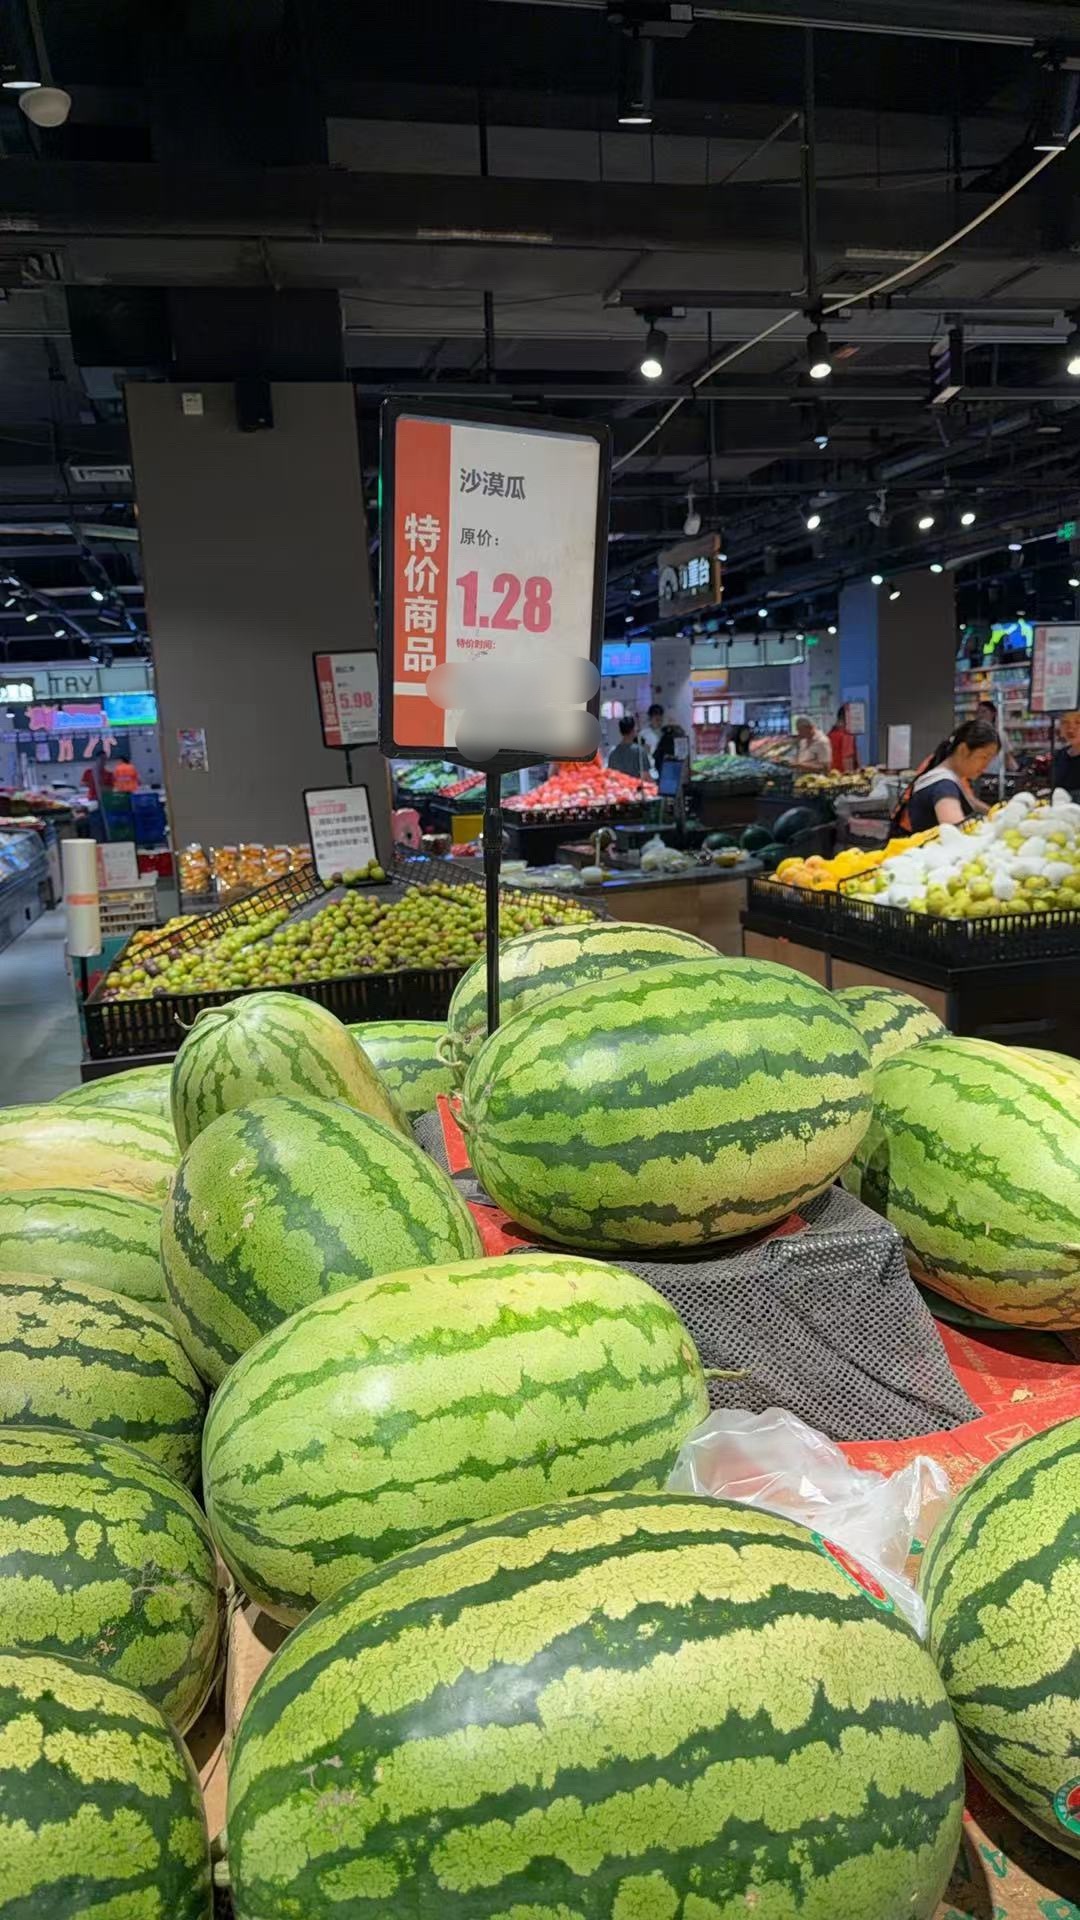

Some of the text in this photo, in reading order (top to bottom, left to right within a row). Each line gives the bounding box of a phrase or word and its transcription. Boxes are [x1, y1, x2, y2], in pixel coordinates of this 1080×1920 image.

[459, 467, 526, 500] 沙漠瓜
[403, 512, 441, 672] 特价商品
[455, 570, 553, 634] 1.28
[37, 675, 94, 694] TRY
